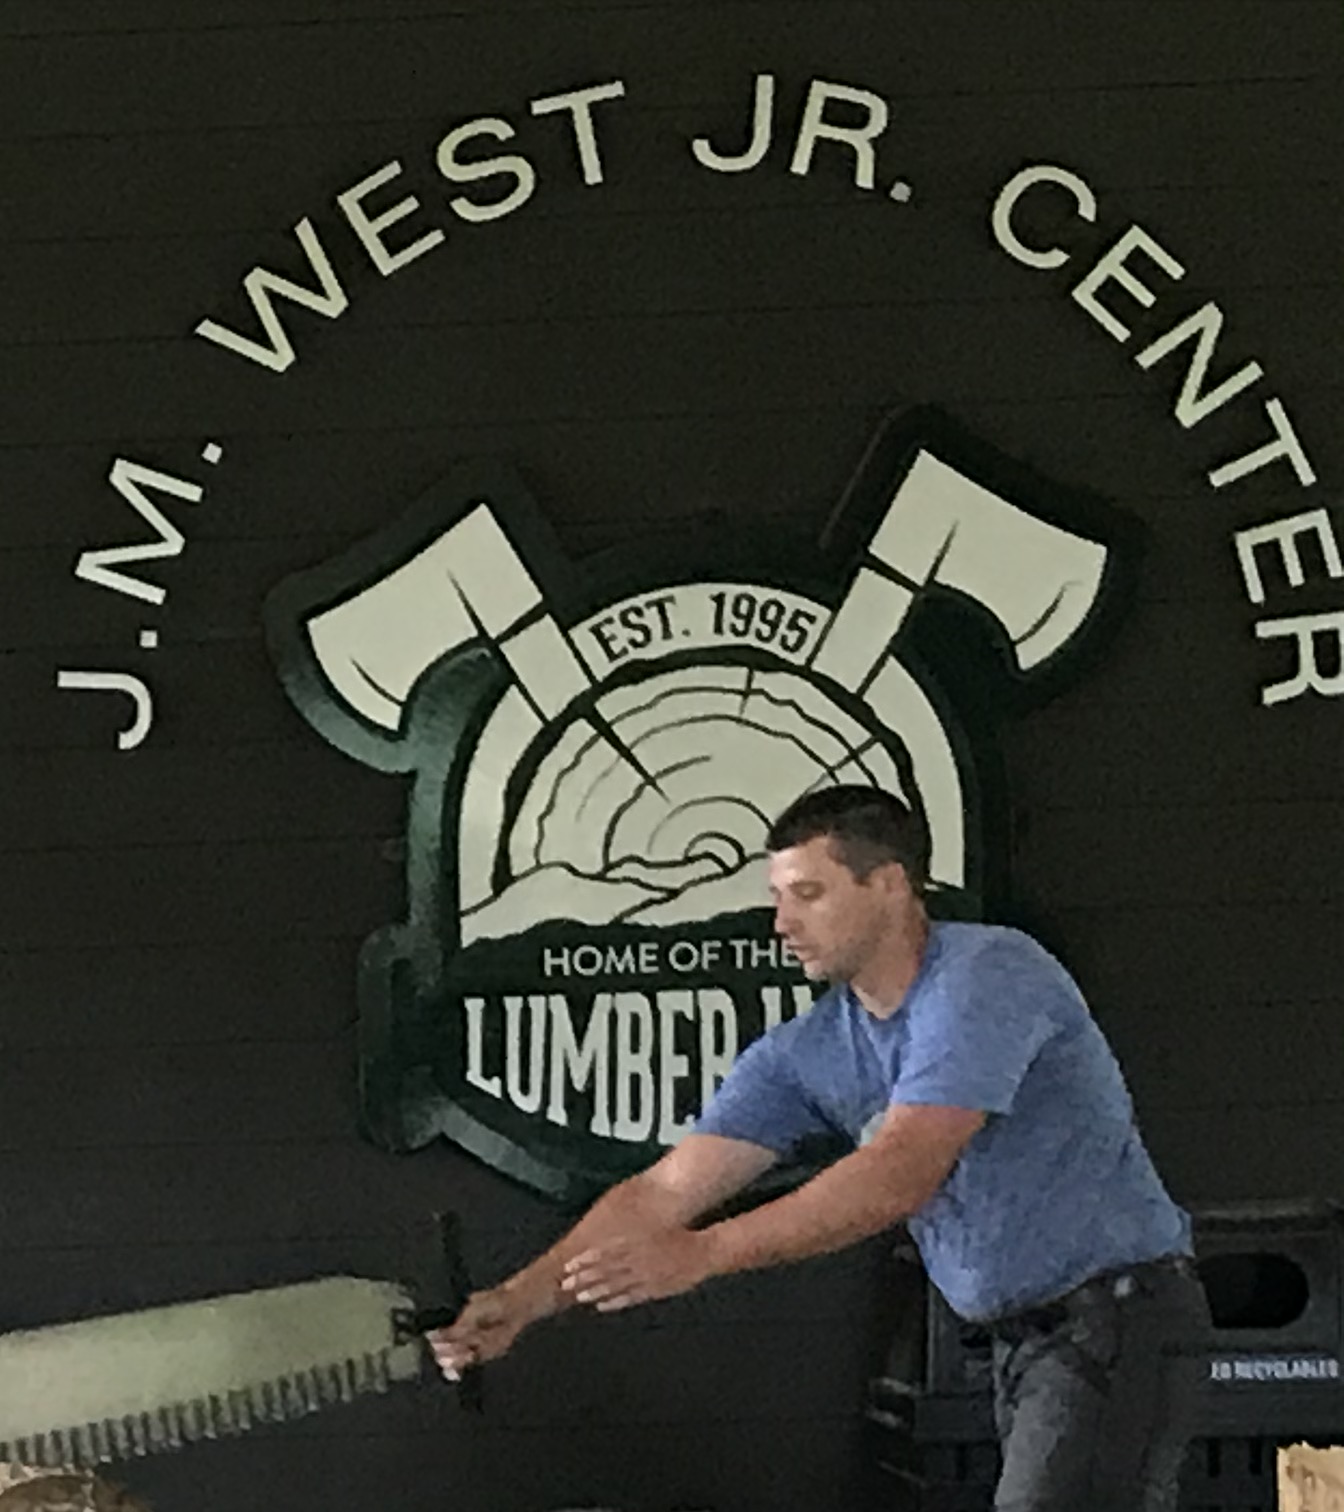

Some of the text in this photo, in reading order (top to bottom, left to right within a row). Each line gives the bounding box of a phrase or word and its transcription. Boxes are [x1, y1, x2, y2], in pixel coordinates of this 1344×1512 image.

[58, 75, 1344, 751] J.M. WEST JR. CENTER
[588, 592, 817, 663] EST. 1995
[544, 938, 801, 976] HOME OF THE
